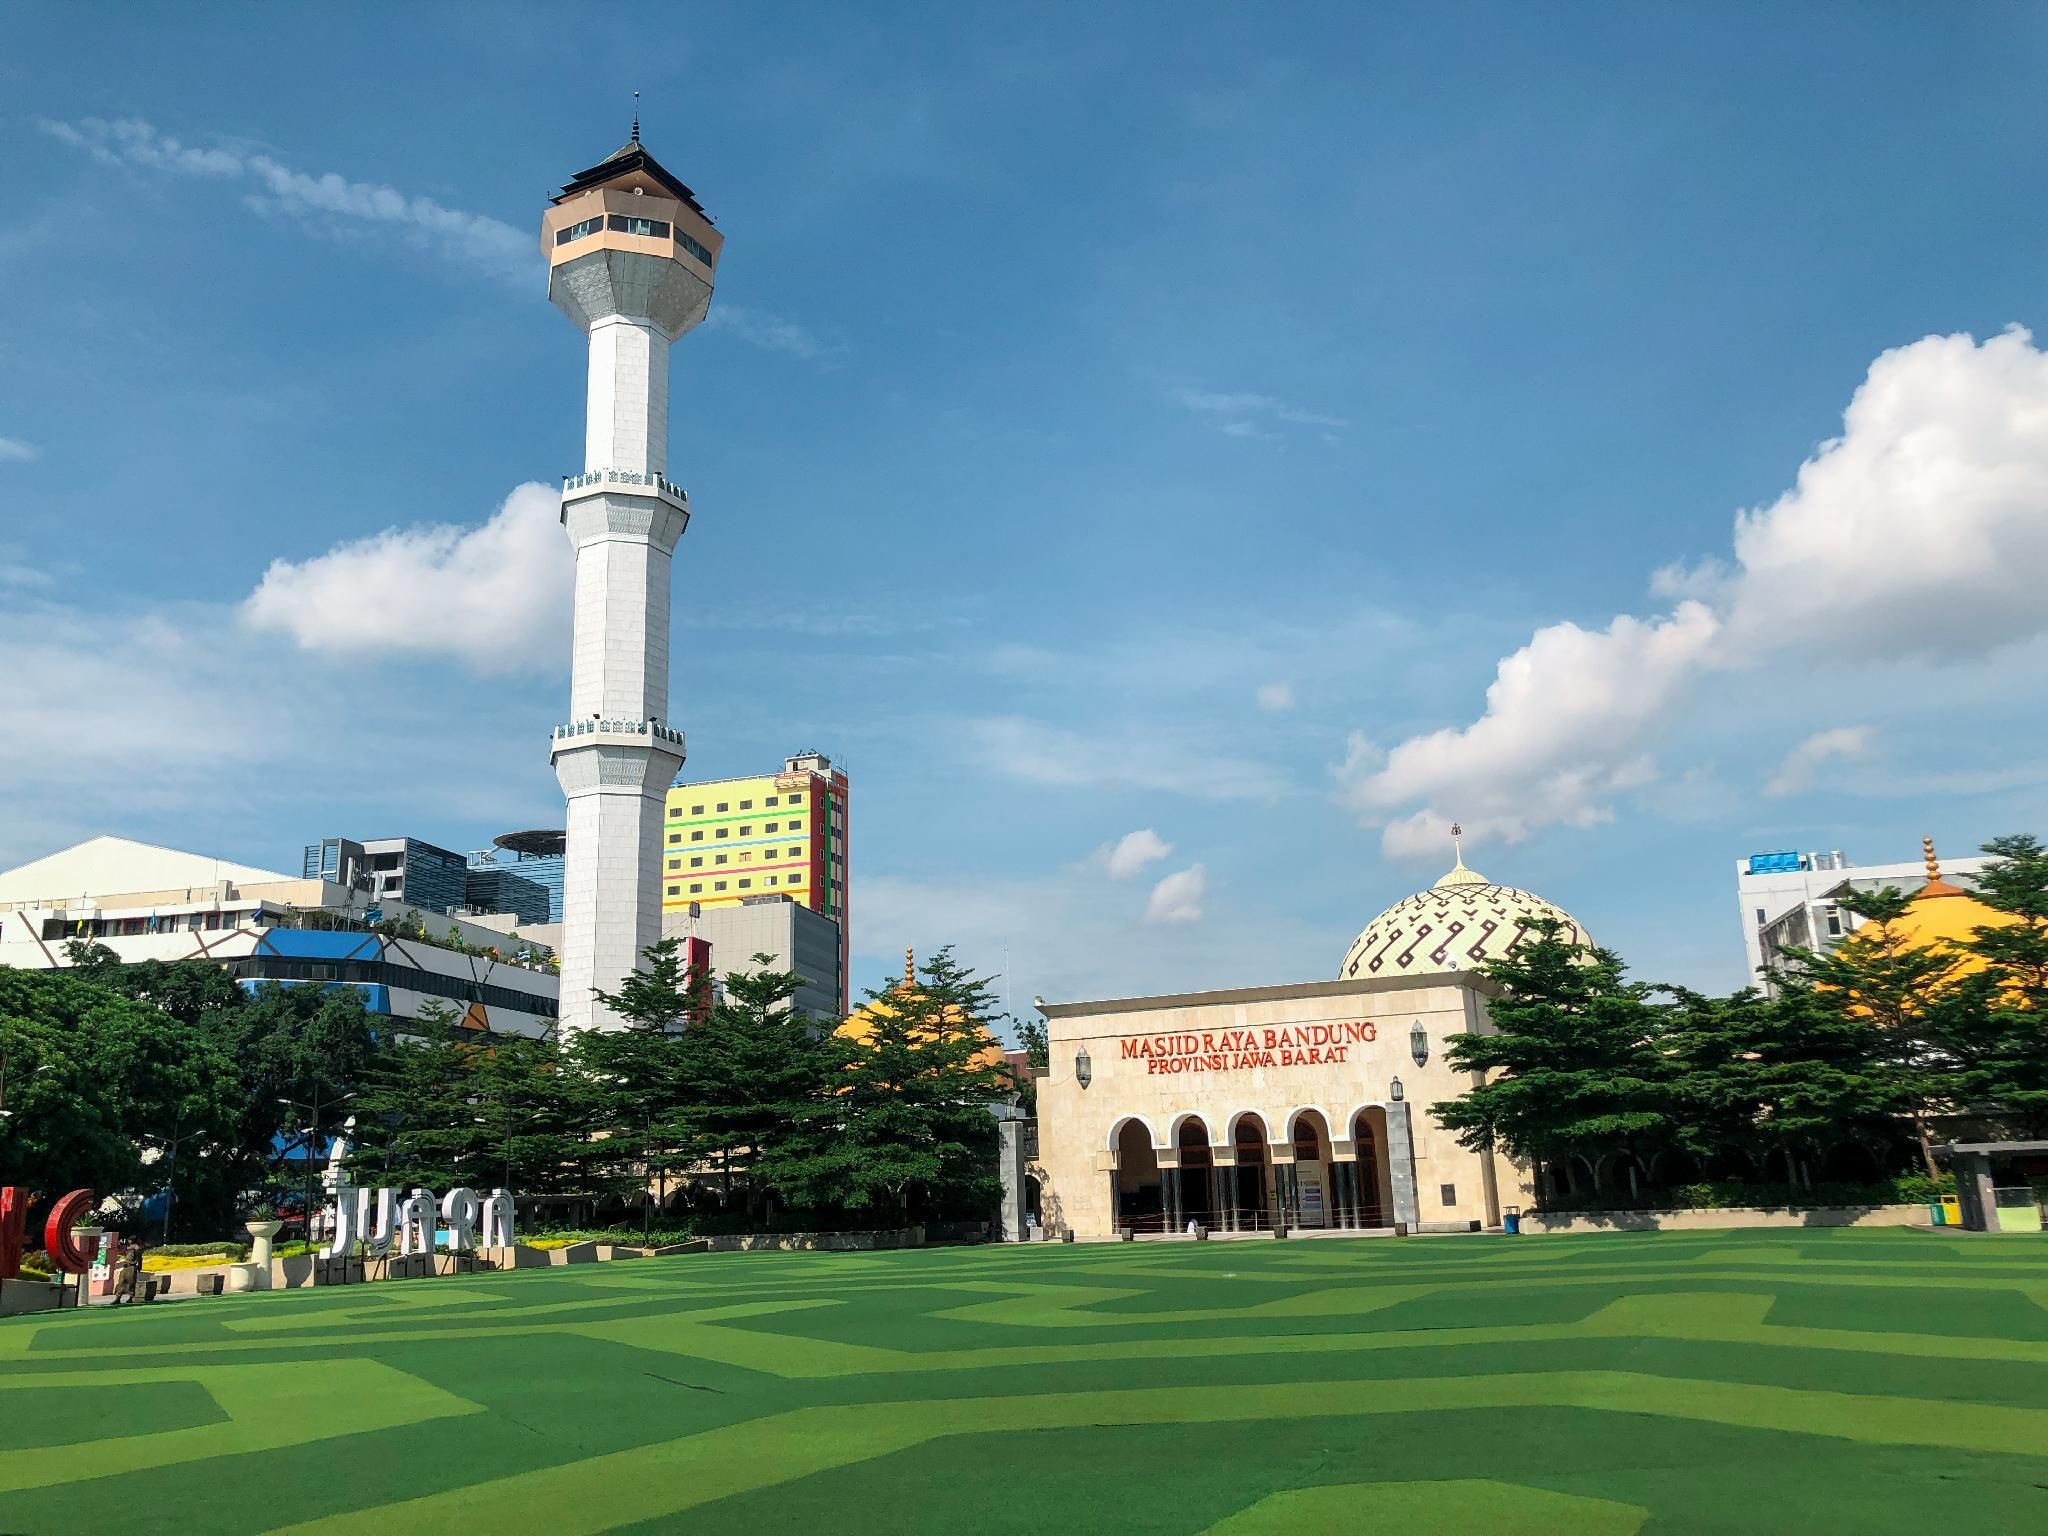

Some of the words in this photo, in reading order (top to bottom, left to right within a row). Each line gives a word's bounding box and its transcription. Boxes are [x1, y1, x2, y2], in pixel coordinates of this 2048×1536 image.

[1120, 1034, 1199, 1060] MASJID
[1202, 1030, 1260, 1054] RAYA
[1262, 1021, 1377, 1050] BANDUNG
[1147, 1053, 1229, 1075] PROVINSI
[1231, 1050, 1278, 1070] JAWA
[1280, 1045, 1349, 1067] BARAT
[319, 1186, 519, 1260] JUARA
